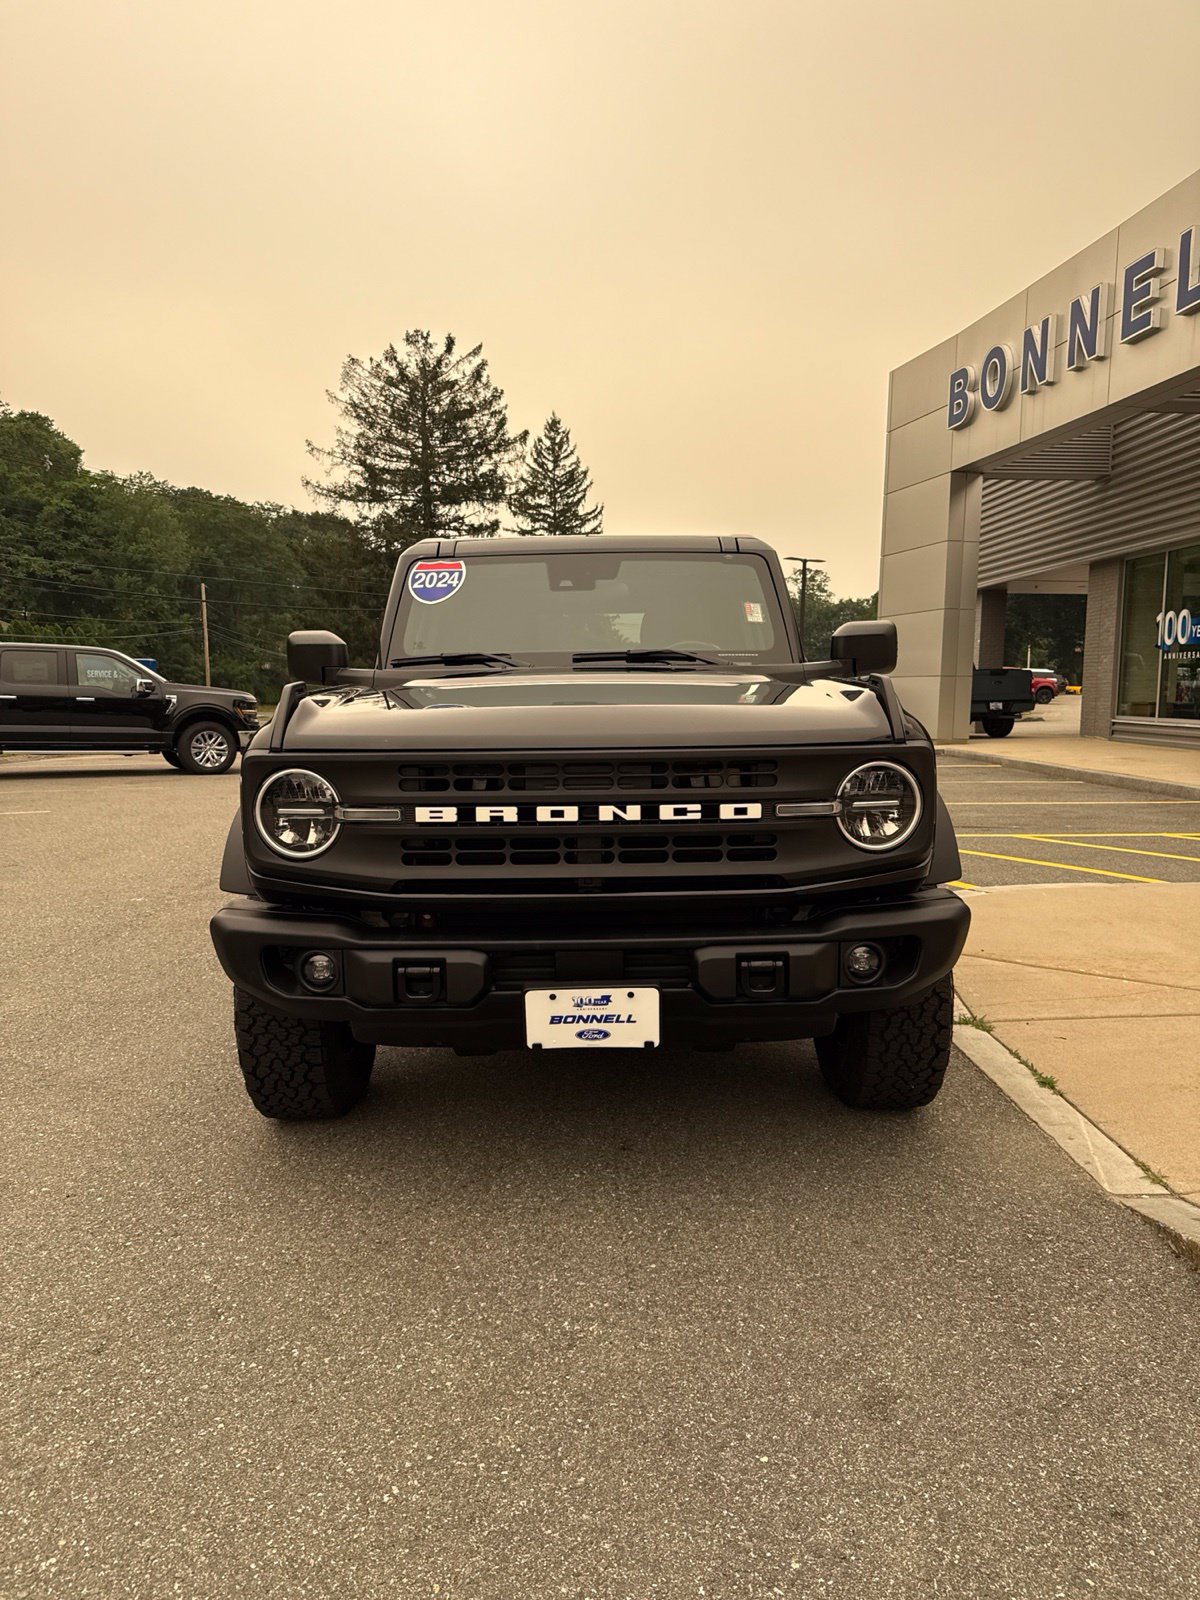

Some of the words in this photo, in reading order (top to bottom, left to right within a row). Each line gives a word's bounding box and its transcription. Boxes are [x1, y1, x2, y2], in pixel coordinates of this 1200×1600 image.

[412, 571, 460, 589] 2024
[1156, 609, 1191, 646] 100
[86, 670, 112, 678] SERVICE
[113, 670, 118, 678] &
[414, 803, 762, 822] BRONCO
[549, 1014, 636, 1024] BONNELL
[581, 1030, 605, 1039] Ford
